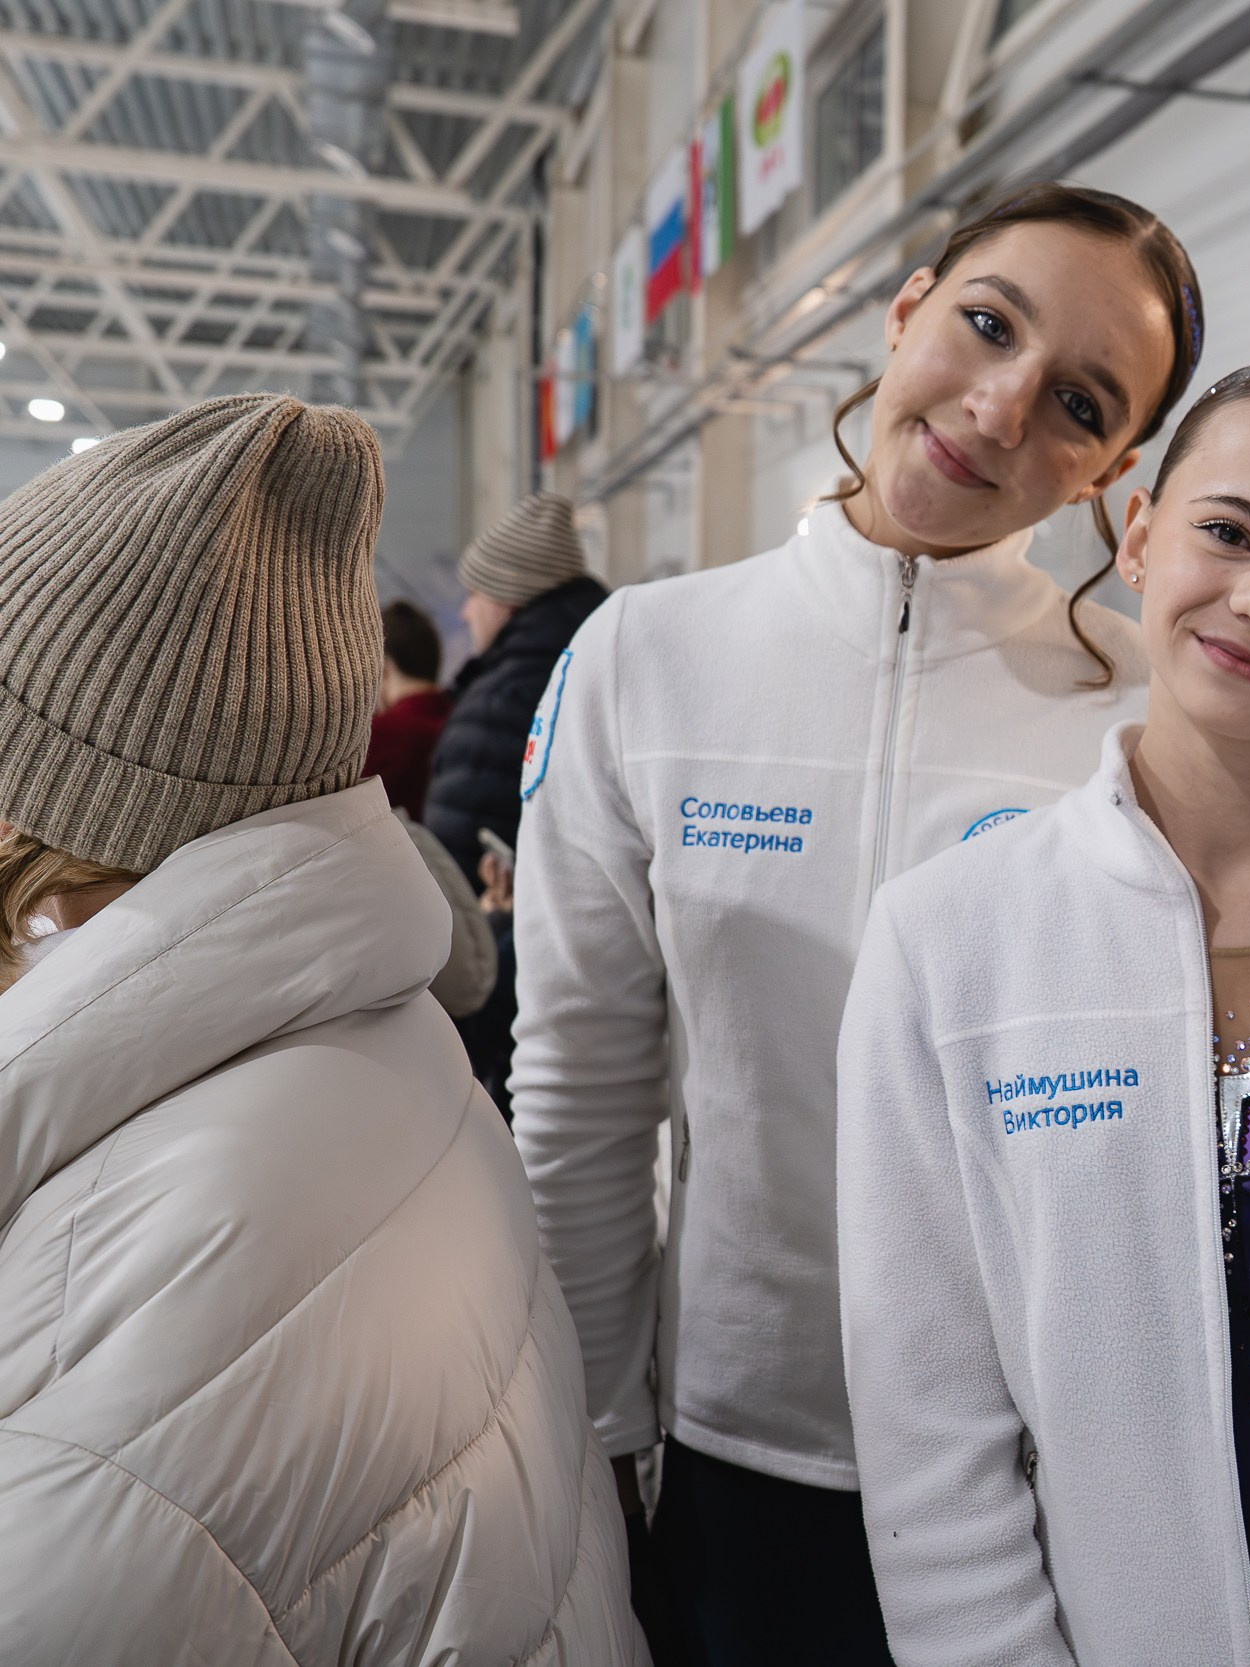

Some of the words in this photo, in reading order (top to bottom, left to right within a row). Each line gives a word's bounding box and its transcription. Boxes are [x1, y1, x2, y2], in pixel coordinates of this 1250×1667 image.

[680, 797, 813, 825] Соловьева
[682, 824, 804, 854] Екатерина
[986, 1068, 1139, 1105] Наймушина
[1003, 1100, 1124, 1135] Виктория
